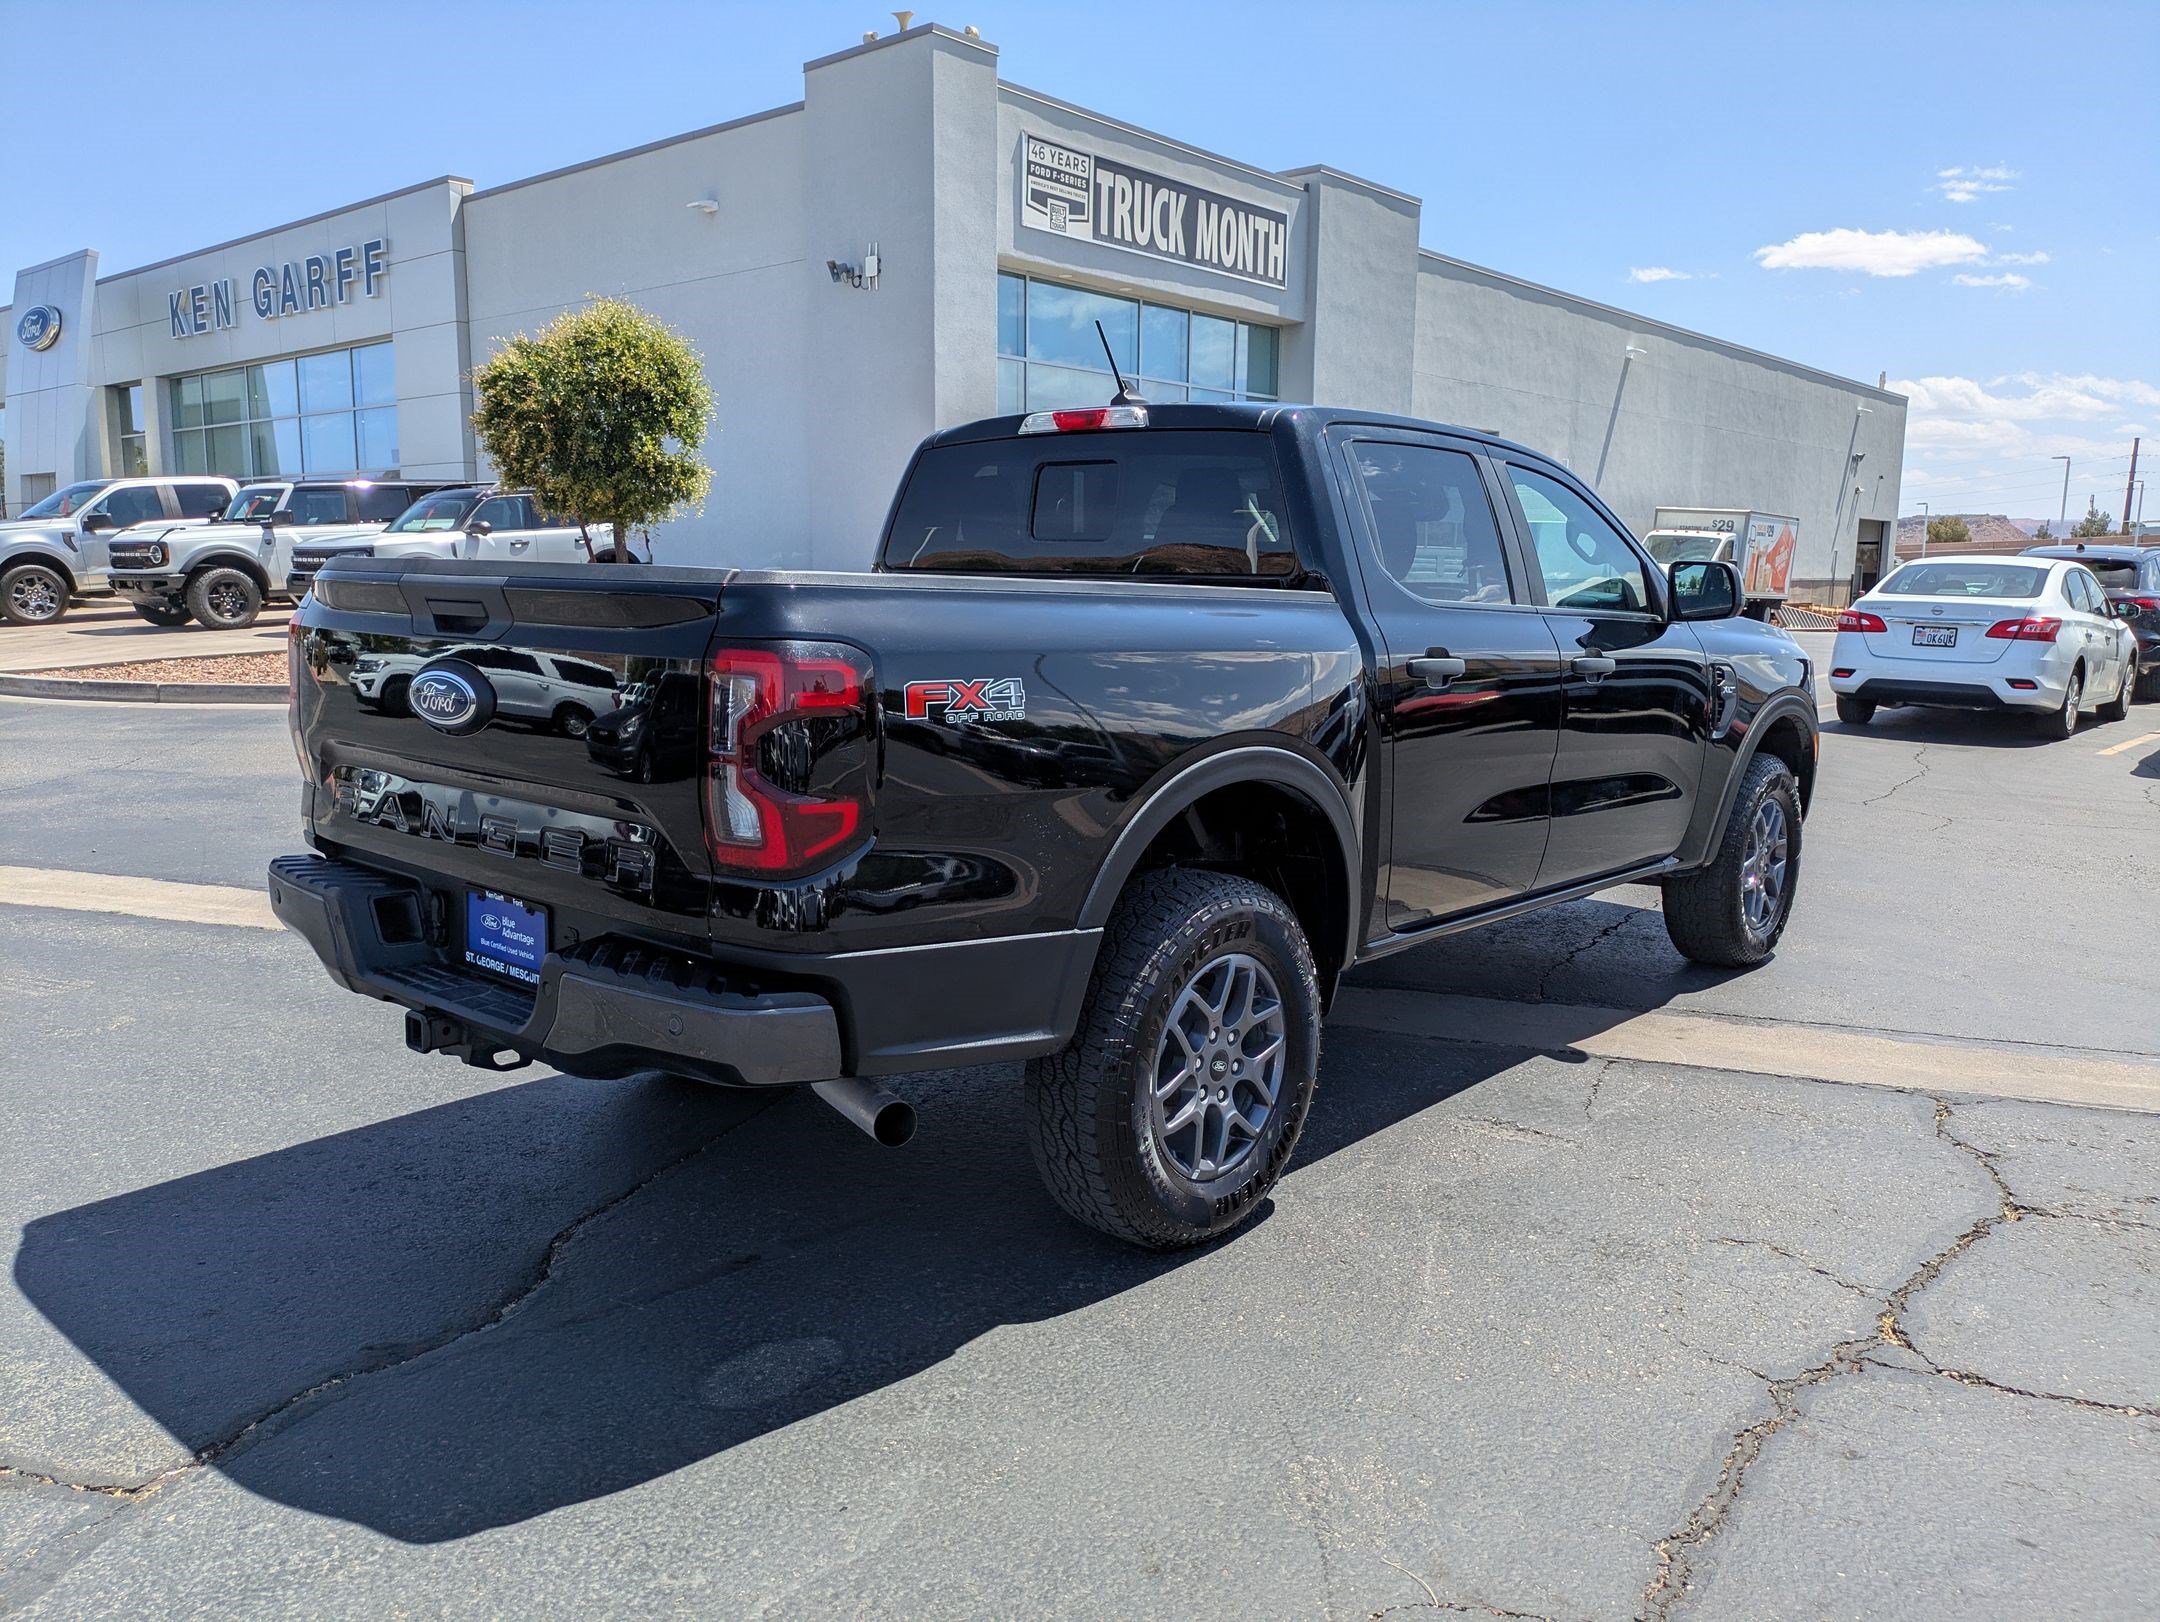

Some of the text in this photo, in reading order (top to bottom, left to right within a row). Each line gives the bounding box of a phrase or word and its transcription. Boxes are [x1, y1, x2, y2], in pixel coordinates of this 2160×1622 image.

[1030, 164, 1051, 178] FORD
[1031, 143, 1087, 173] 46 YEARS
[1096, 167, 1285, 281] TRUCK MONTH
[168, 238, 385, 339] KEN GARFF
[21, 314, 43, 340] Ford
[1711, 519, 1735, 532] $29
[420, 681, 456, 713] Ford
[904, 678, 1026, 721] FX4
[945, 711, 1026, 724] OFF ROAD
[333, 776, 656, 892] RANGER
[502, 928, 535, 946] Advantage
[465, 952, 476, 964] ST.
[476, 954, 505, 973] GEORGE
[490, 941, 507, 953] Certified
[507, 946, 518, 956] Used
[518, 949, 535, 961] Vehicle
